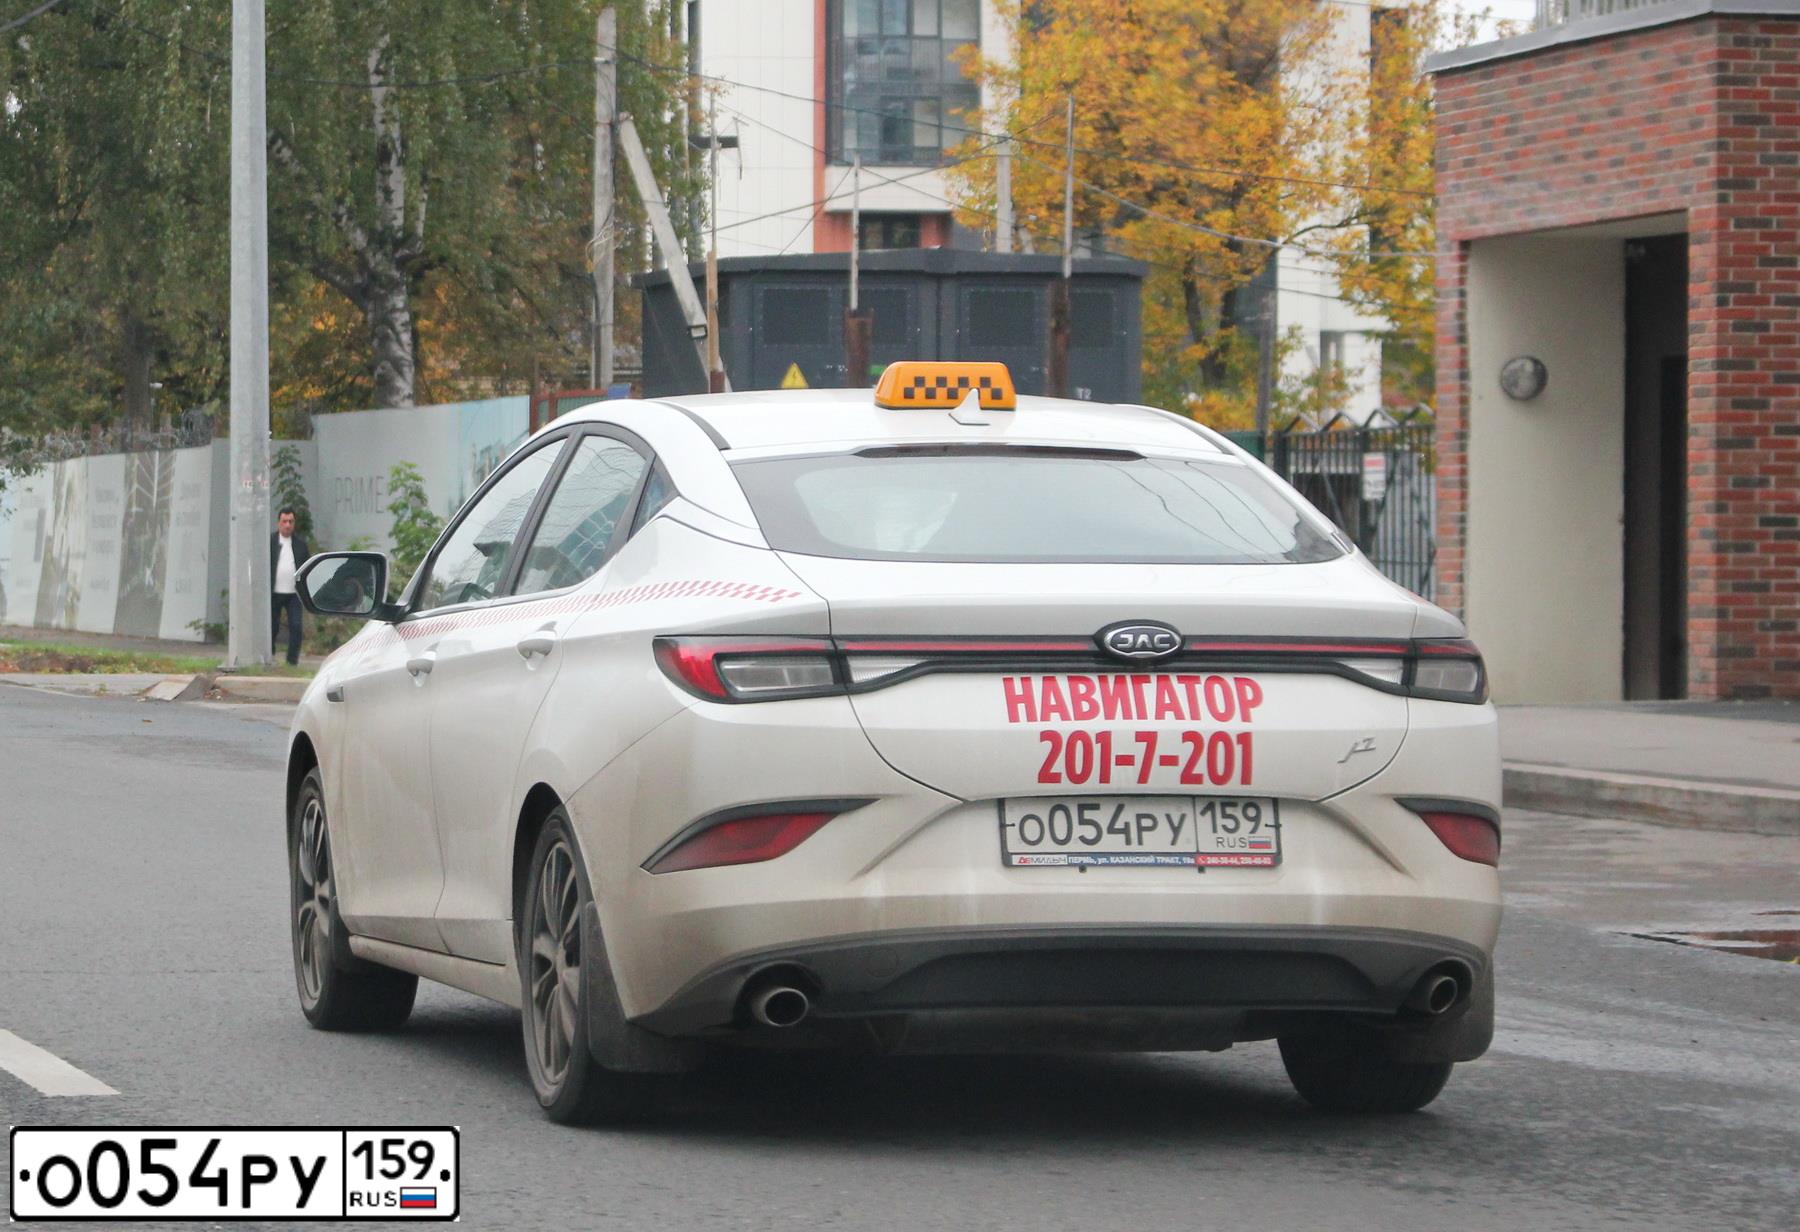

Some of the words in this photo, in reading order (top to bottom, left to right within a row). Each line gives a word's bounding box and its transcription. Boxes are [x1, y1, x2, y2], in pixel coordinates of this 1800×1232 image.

[335, 476, 385, 513] PRIME
[1117, 633, 1171, 649] JAC
[1002, 674, 1264, 724] НАВИГАТОР
[1037, 729, 1254, 786] 201-7-201
[1200, 800, 1263, 836] 159
[1216, 836, 1247, 849] RUS
